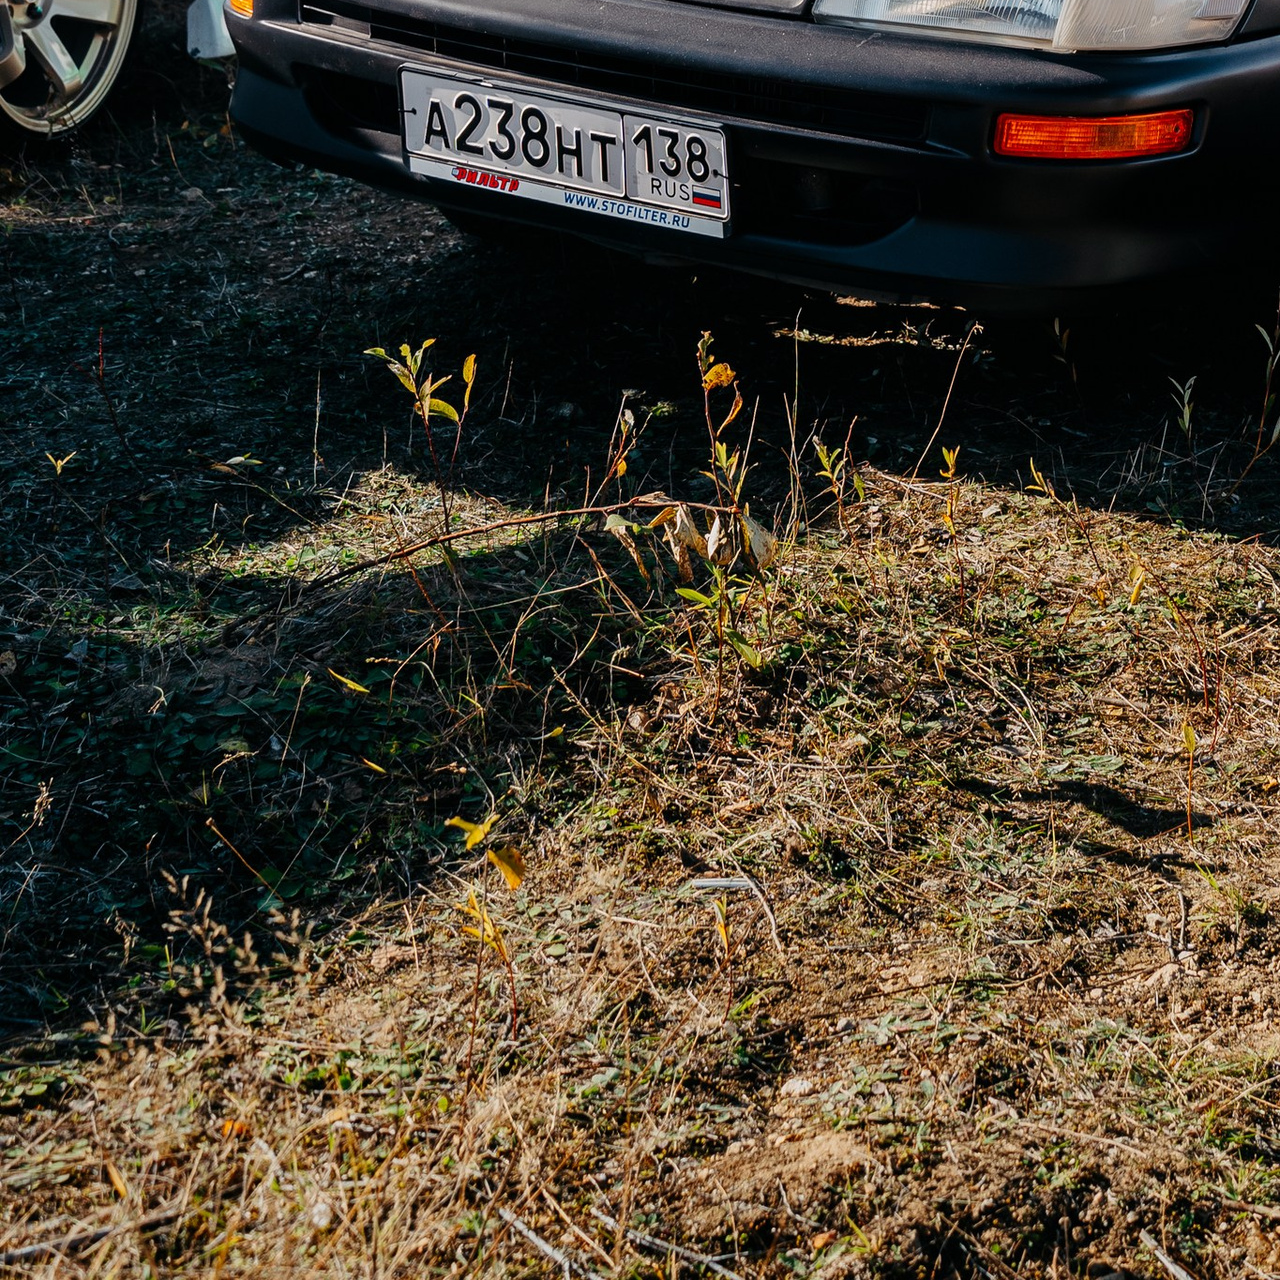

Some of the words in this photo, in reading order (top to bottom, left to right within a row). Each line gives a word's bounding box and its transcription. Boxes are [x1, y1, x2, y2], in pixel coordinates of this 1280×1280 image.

[631, 123, 711, 183] 138
[651, 177, 691, 202] RUS
[563, 191, 692, 229] WWW.STOFILTER.RU
